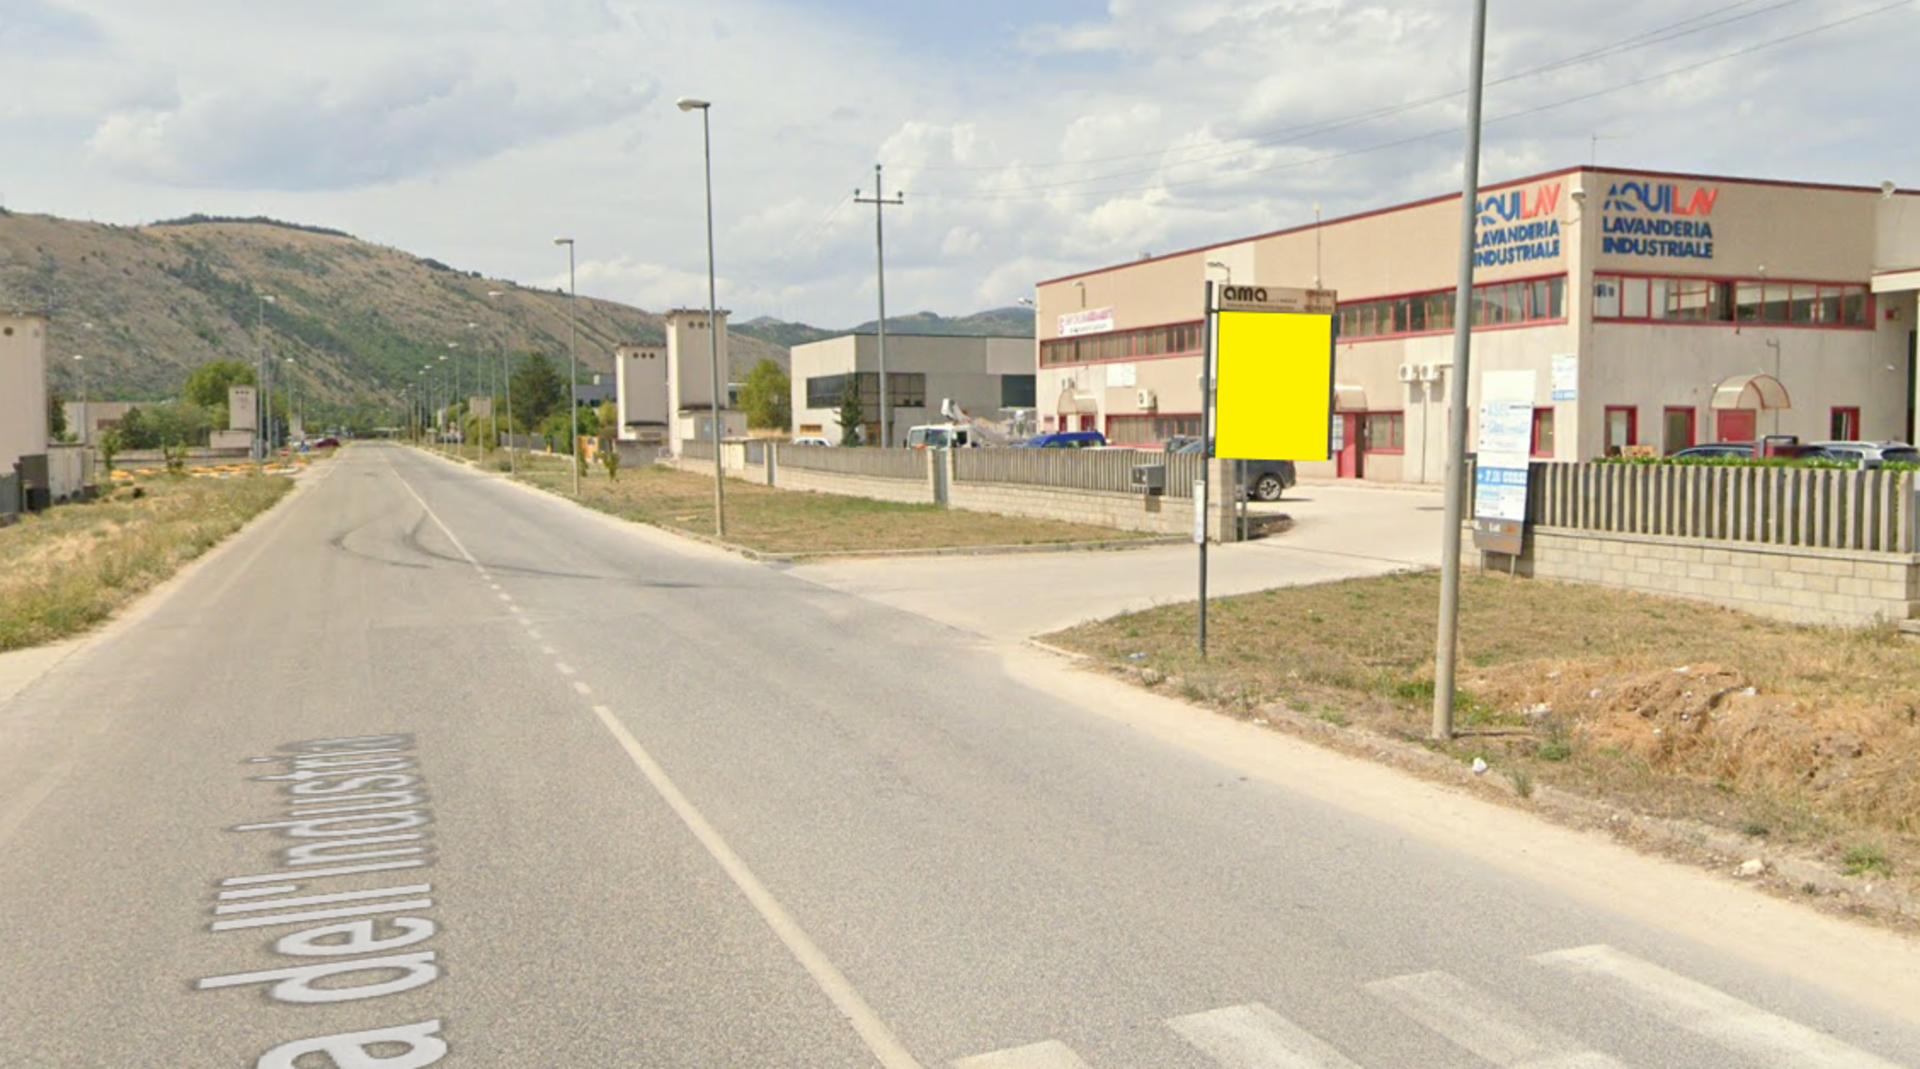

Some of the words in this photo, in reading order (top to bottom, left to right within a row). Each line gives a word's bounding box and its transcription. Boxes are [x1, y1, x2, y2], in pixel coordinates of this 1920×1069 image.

[1603, 182, 1717, 215] AQUILAV
[1603, 216, 1712, 238] LAVANDERIA
[1472, 239, 1561, 268] INDUSTRIALE
[1603, 238, 1713, 259] INDUSTRIALE
[1223, 286, 1268, 303] ama
